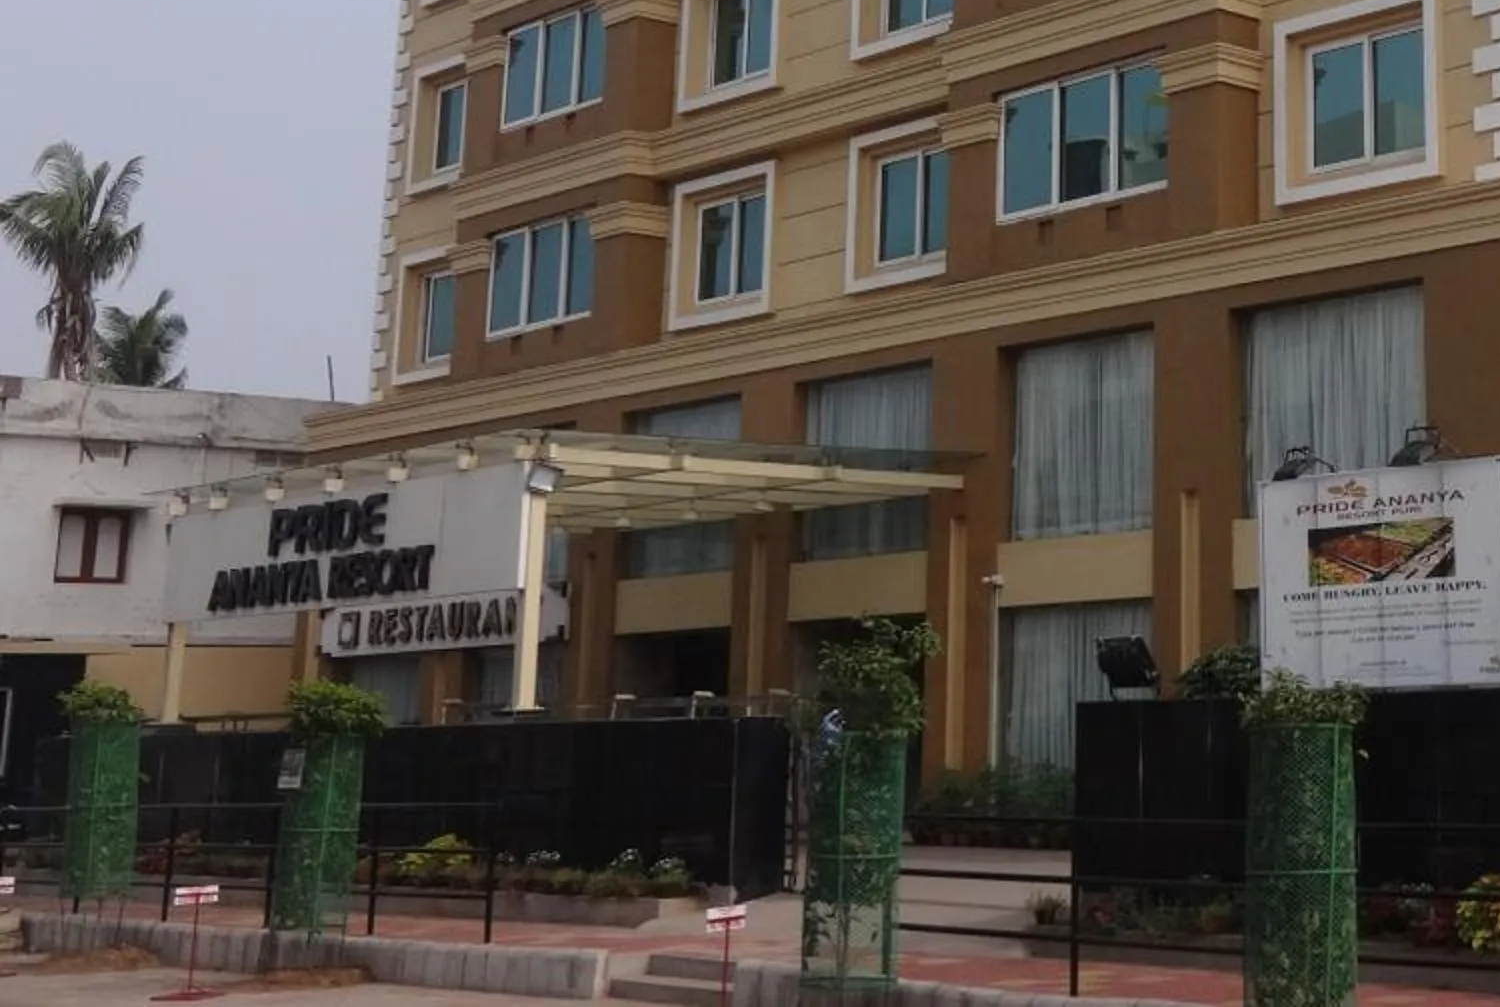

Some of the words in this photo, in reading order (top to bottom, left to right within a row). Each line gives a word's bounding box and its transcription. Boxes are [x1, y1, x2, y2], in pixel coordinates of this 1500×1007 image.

[268, 493, 388, 558] PRIDE
[1296, 500, 1364, 517] PRIDE
[1373, 489, 1465, 509] ANANYA
[207, 559, 322, 613] ANANYA
[326, 544, 435, 599] RESORT
[367, 597, 517, 646] RESTAURAN
